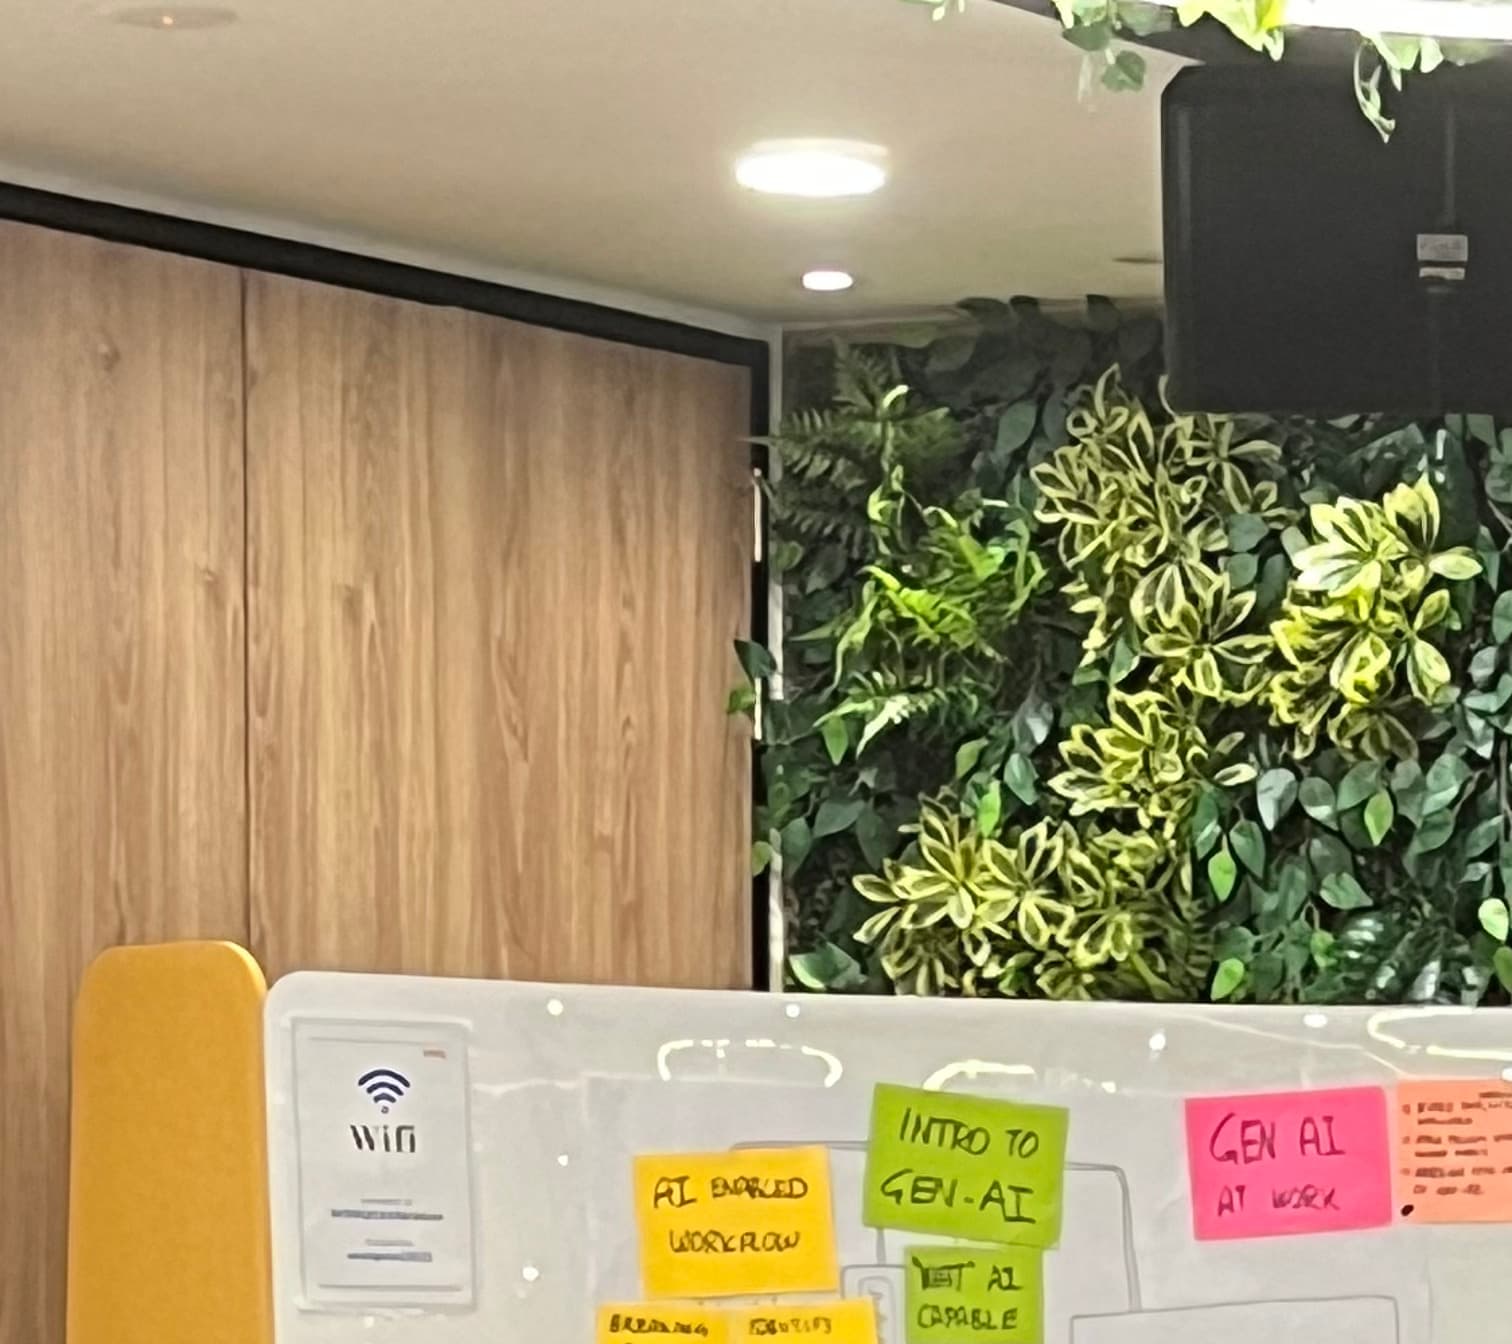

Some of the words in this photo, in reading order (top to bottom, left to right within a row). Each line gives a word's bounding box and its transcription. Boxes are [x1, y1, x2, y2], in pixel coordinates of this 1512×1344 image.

[900, 1107, 991, 1156] INTRO
[1005, 1128, 1040, 1159] TO
[1209, 1112, 1276, 1165] GEN
[1299, 1115, 1346, 1157] AI
[653, 1175, 698, 1209] AI
[1217, 1184, 1247, 1217] AT
[1272, 1184, 1341, 1211] WORK
[987, 1264, 1024, 1292] AI
[917, 1303, 1019, 1331] CAPABLE
